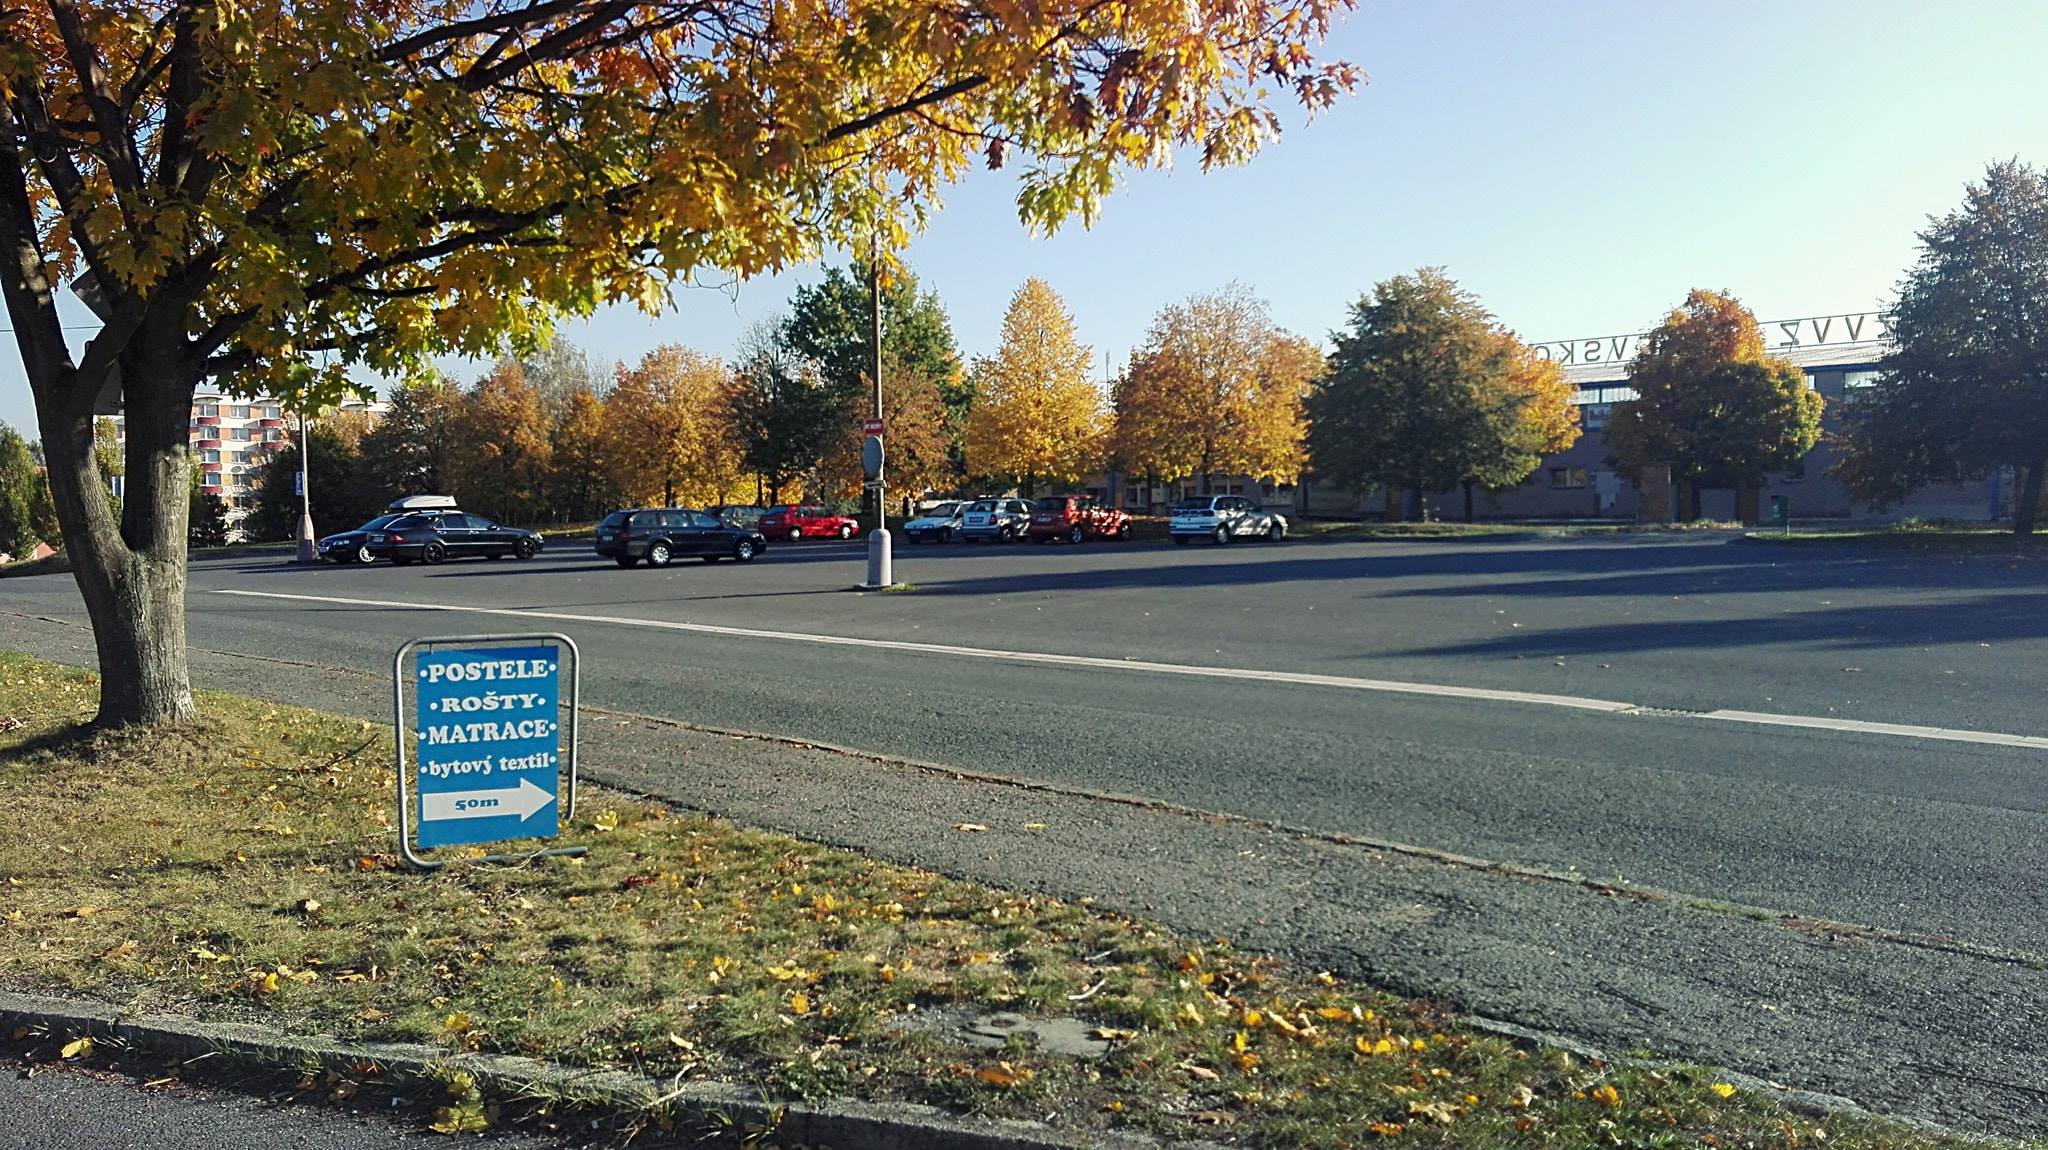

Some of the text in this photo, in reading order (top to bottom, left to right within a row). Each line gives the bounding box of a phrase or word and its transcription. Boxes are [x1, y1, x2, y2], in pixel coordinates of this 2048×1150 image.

[428, 659, 548, 683] POSTELE
[441, 691, 539, 713] ROŠTY
[428, 719, 549, 745] MATRACE
[429, 752, 550, 779] bytový textil
[455, 797, 500, 811] 50m
